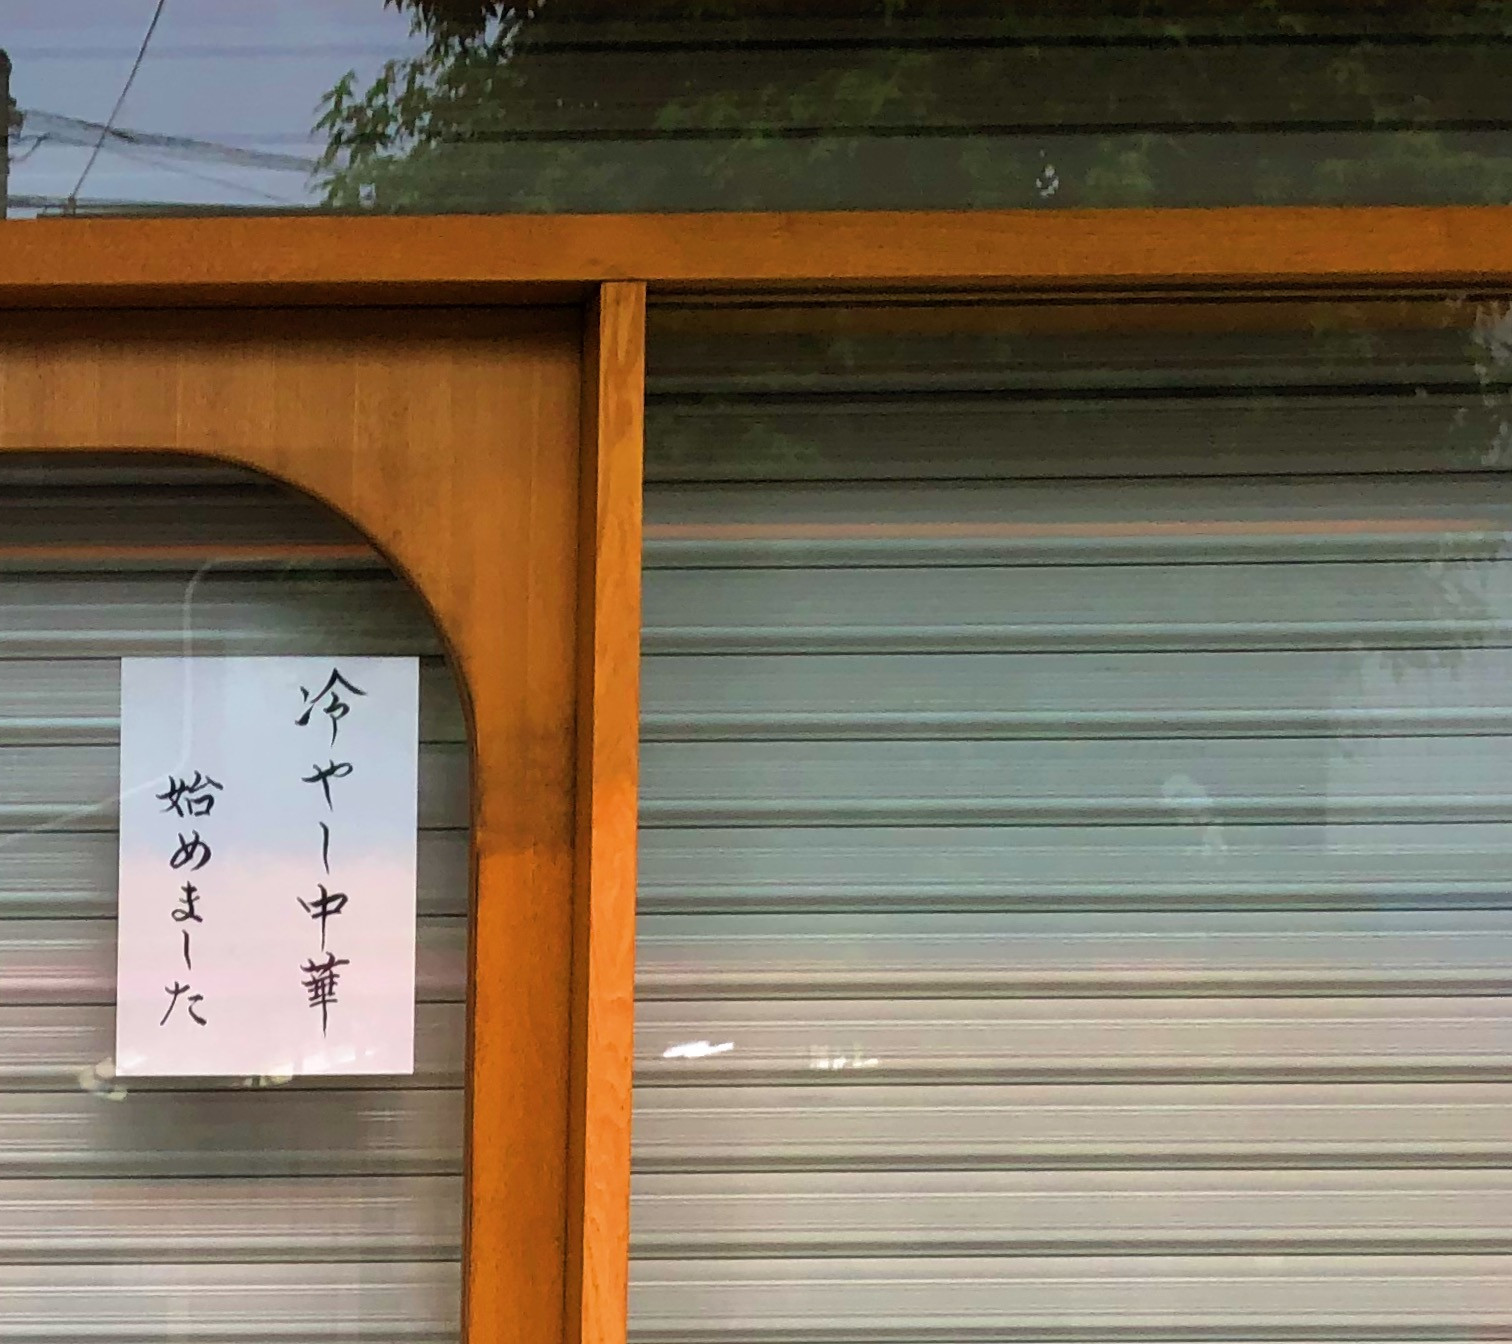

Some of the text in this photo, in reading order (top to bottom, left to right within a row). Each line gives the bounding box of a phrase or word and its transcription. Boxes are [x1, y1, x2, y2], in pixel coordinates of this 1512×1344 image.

[156, 770, 224, 1027] 始めました
[295, 667, 368, 1038] 冷やし中華
